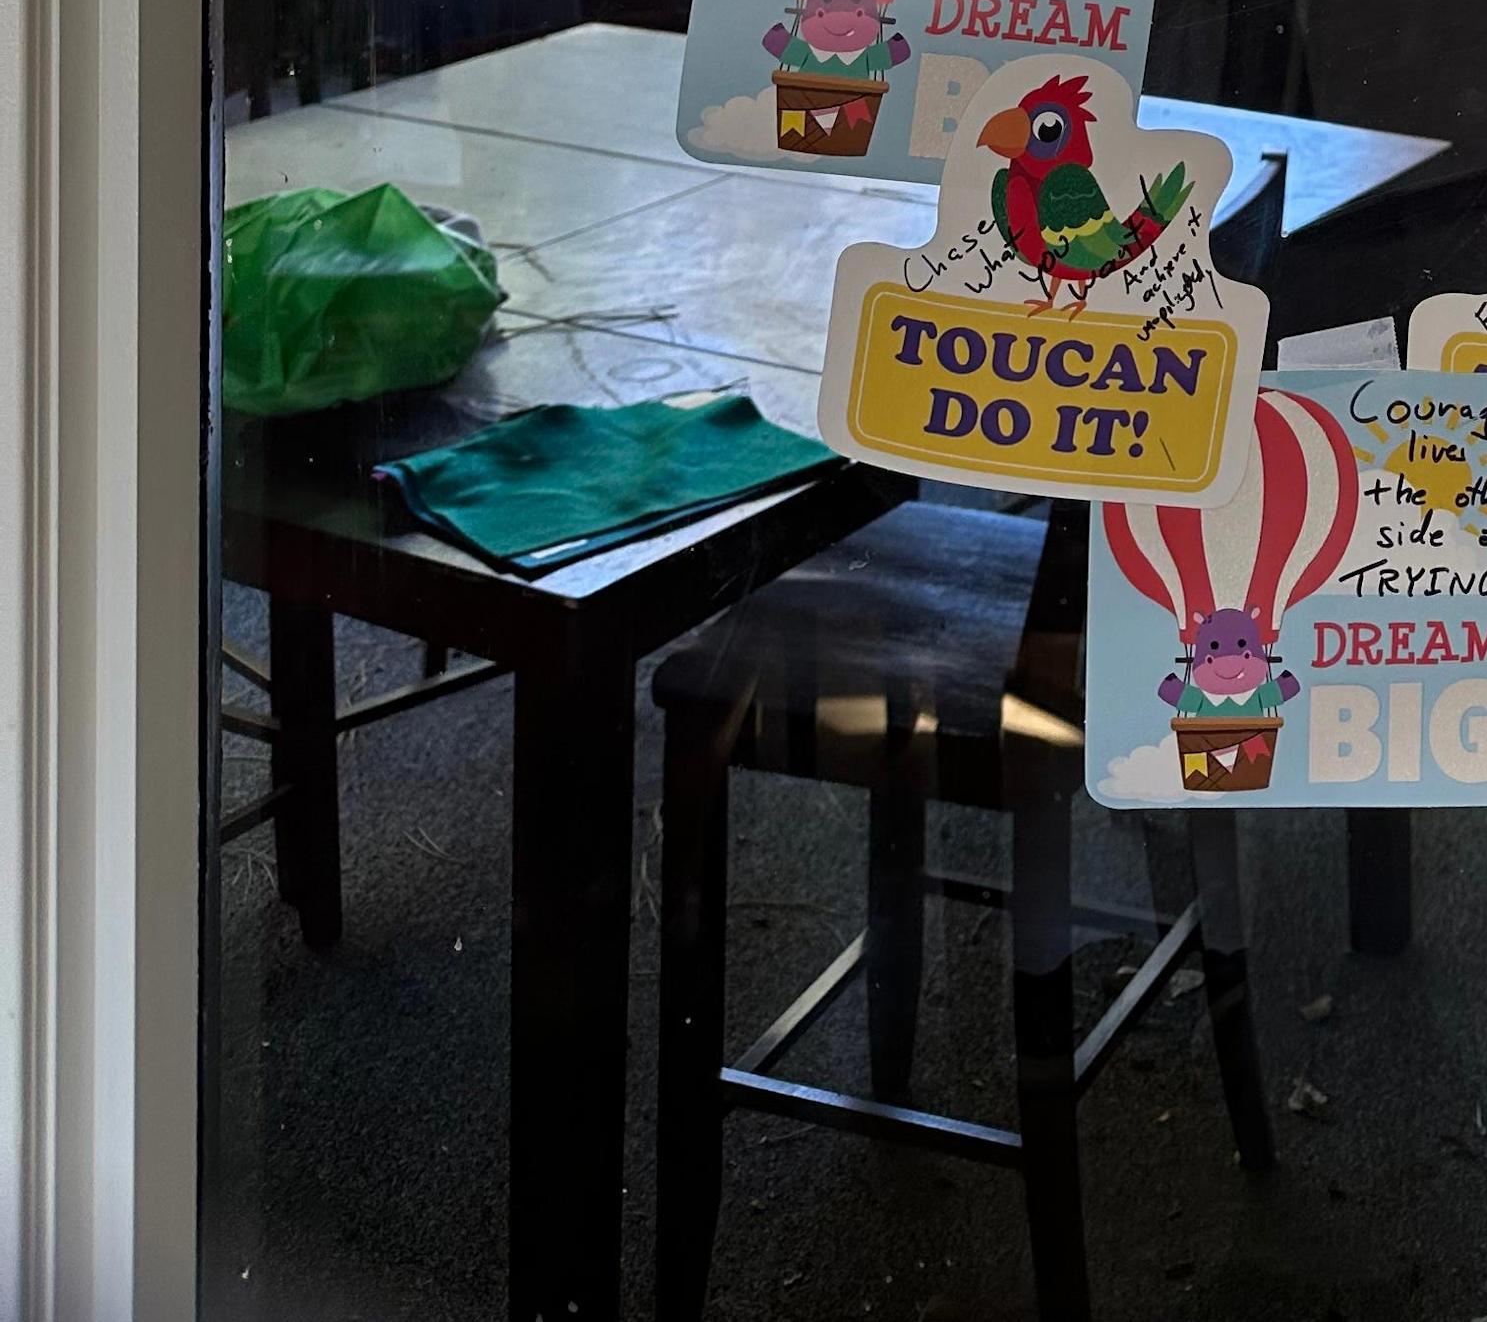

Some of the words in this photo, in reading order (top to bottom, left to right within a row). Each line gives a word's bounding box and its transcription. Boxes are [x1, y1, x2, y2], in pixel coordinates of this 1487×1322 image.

[902, 218, 998, 293] Chase
[1018, 234, 1071, 300] you
[1067, 219, 1145, 302] want
[1187, 205, 1204, 239] it
[890, 314, 1208, 397] TOUCAN
[922, 386, 1032, 447] DO
[1050, 404, 1150, 458] IT!
[1408, 429, 1467, 465] lives
[1363, 472, 1428, 507] the
[1375, 508, 1446, 548] side
